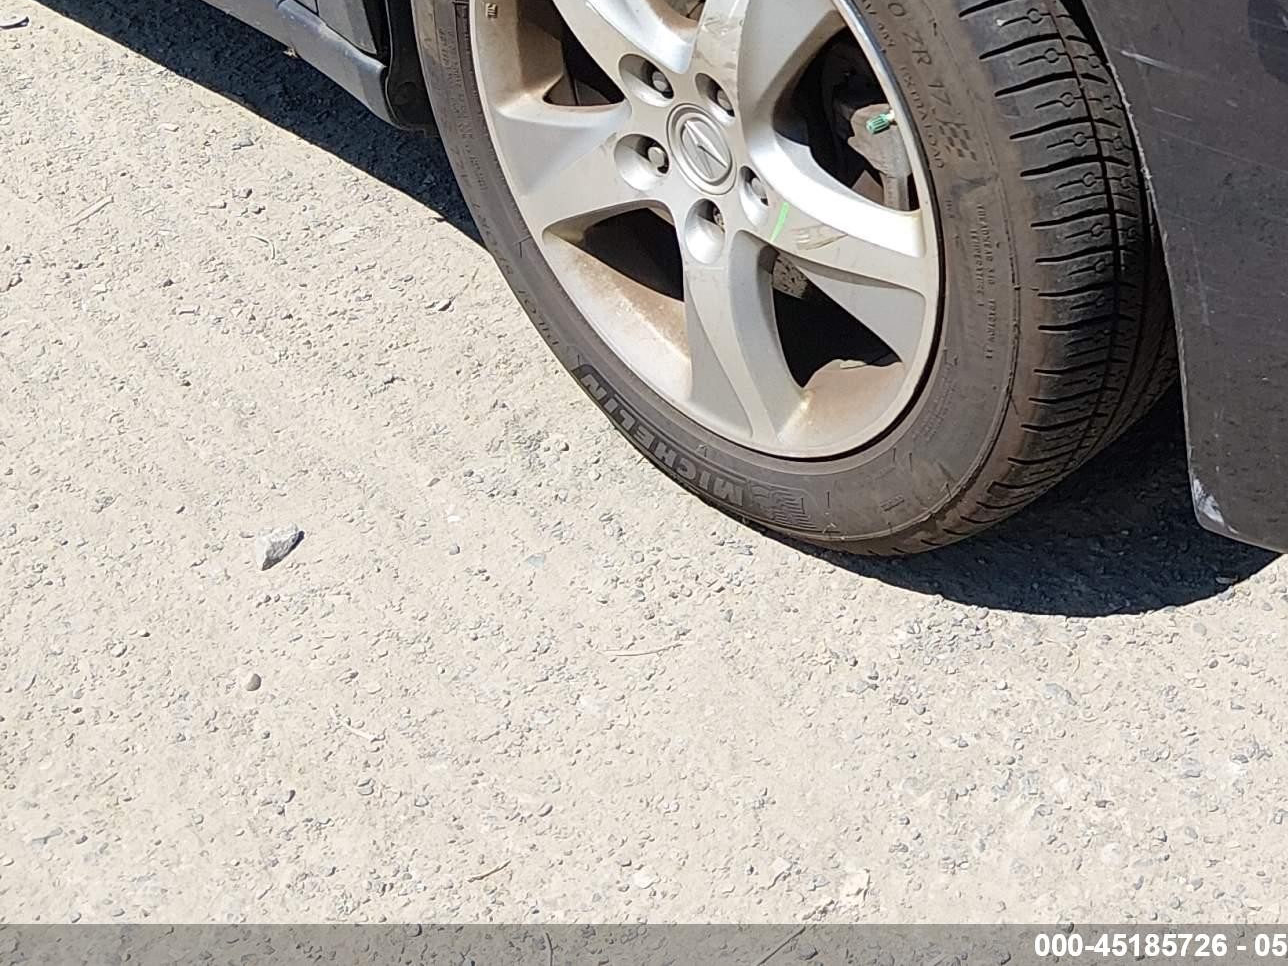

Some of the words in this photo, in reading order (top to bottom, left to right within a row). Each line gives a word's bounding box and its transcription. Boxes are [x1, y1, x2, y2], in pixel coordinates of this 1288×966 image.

[902, 31, 933, 66] ZR
[928, 77, 952, 107] 17
[580, 373, 745, 507] MICHELIN
